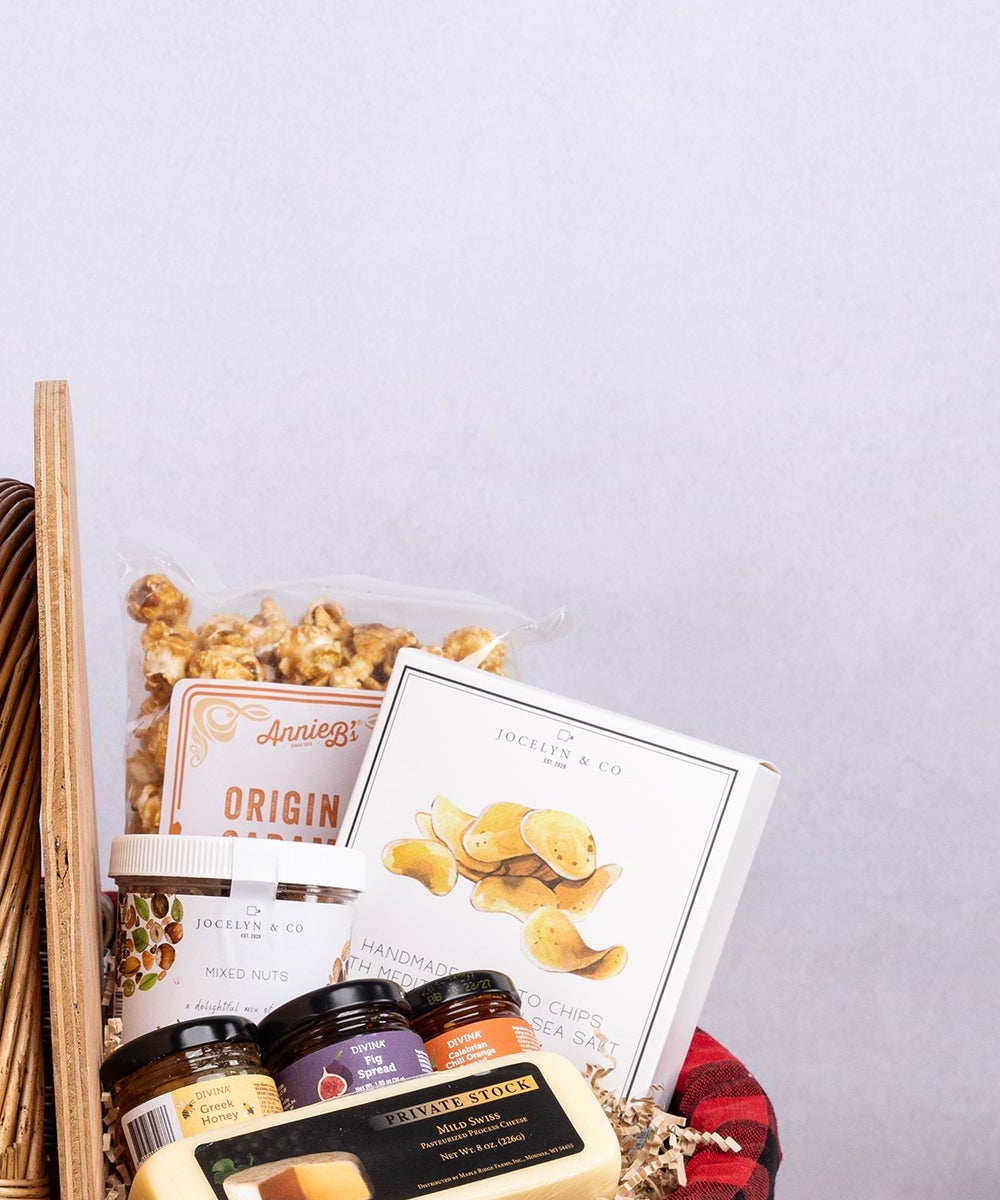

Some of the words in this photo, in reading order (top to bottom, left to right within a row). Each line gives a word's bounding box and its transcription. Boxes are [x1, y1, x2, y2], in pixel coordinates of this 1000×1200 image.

[495, 729, 571, 760] JOCELYN
[579, 755, 590, 767] &
[598, 761, 622, 776] CO
[224, 786, 341, 828] ORIGIN
[196, 918, 262, 931] JOCELYN
[270, 923, 279, 932] &
[286, 923, 304, 933] CO
[205, 967, 245, 979] MIXED
[252, 969, 289, 982] NUTS
[194, 1000, 239, 1014] delightful
[243, 1005, 258, 1013] mix
[548, 1000, 604, 1029] CHIPS
[447, 1031, 481, 1049] DIVINA
[532, 1016, 565, 1039] SEA
[572, 1032, 620, 1055] SALT
[351, 1039, 385, 1054] DIVINA
[448, 1042, 487, 1059] Calabrian
[364, 1055, 383, 1066] Fig
[445, 1057, 465, 1070] Chili
[466, 1047, 497, 1061] Orange
[358, 1063, 397, 1080] Spread
[195, 1086, 230, 1100] DIVINA
[200, 1100, 234, 1114] Greek
[384, 1096, 464, 1125] PRIVATE
[470, 1079, 532, 1104] STOCK
[201, 1111, 239, 1126] Honey
[477, 1144, 483, 1152] 8
